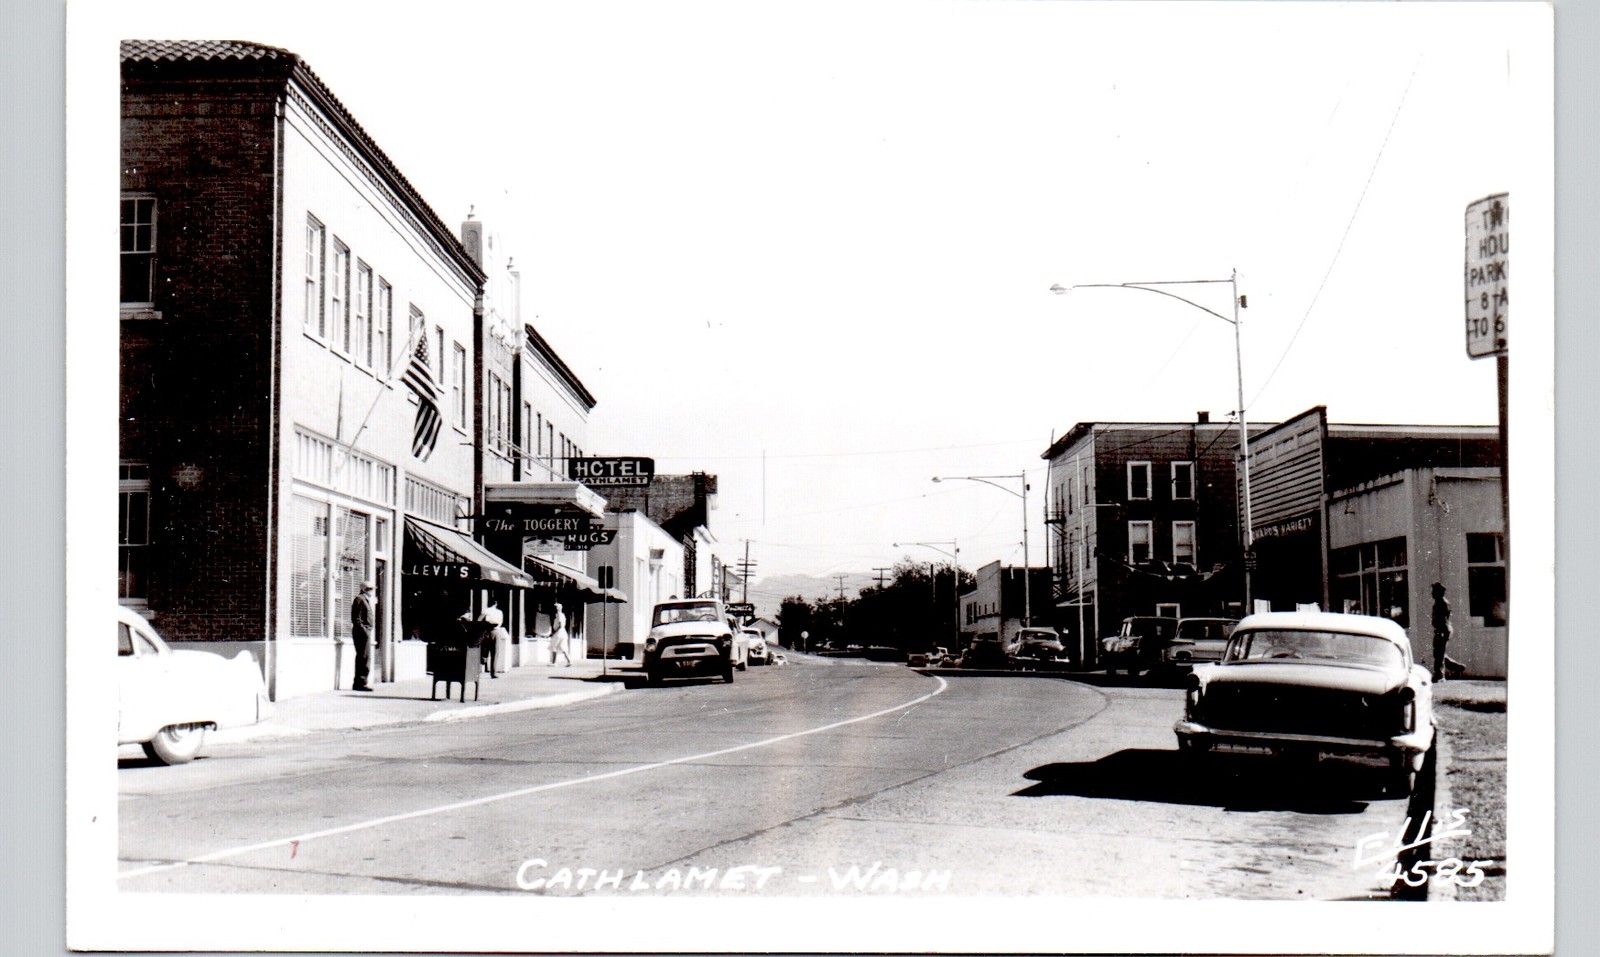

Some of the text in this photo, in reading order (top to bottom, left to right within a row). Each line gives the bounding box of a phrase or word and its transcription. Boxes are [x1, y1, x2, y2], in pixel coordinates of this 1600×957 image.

[1482, 205, 1509, 231] TW
[1481, 291, 1489, 311] 8
[1494, 315, 1505, 334] 6
[575, 460, 649, 477] HOTEL
[485, 519, 515, 531] The
[523, 519, 581, 531] TOGGERY
[1281, 516, 1313, 537] VARIETY
[412, 564, 470, 578] LEVI'S
